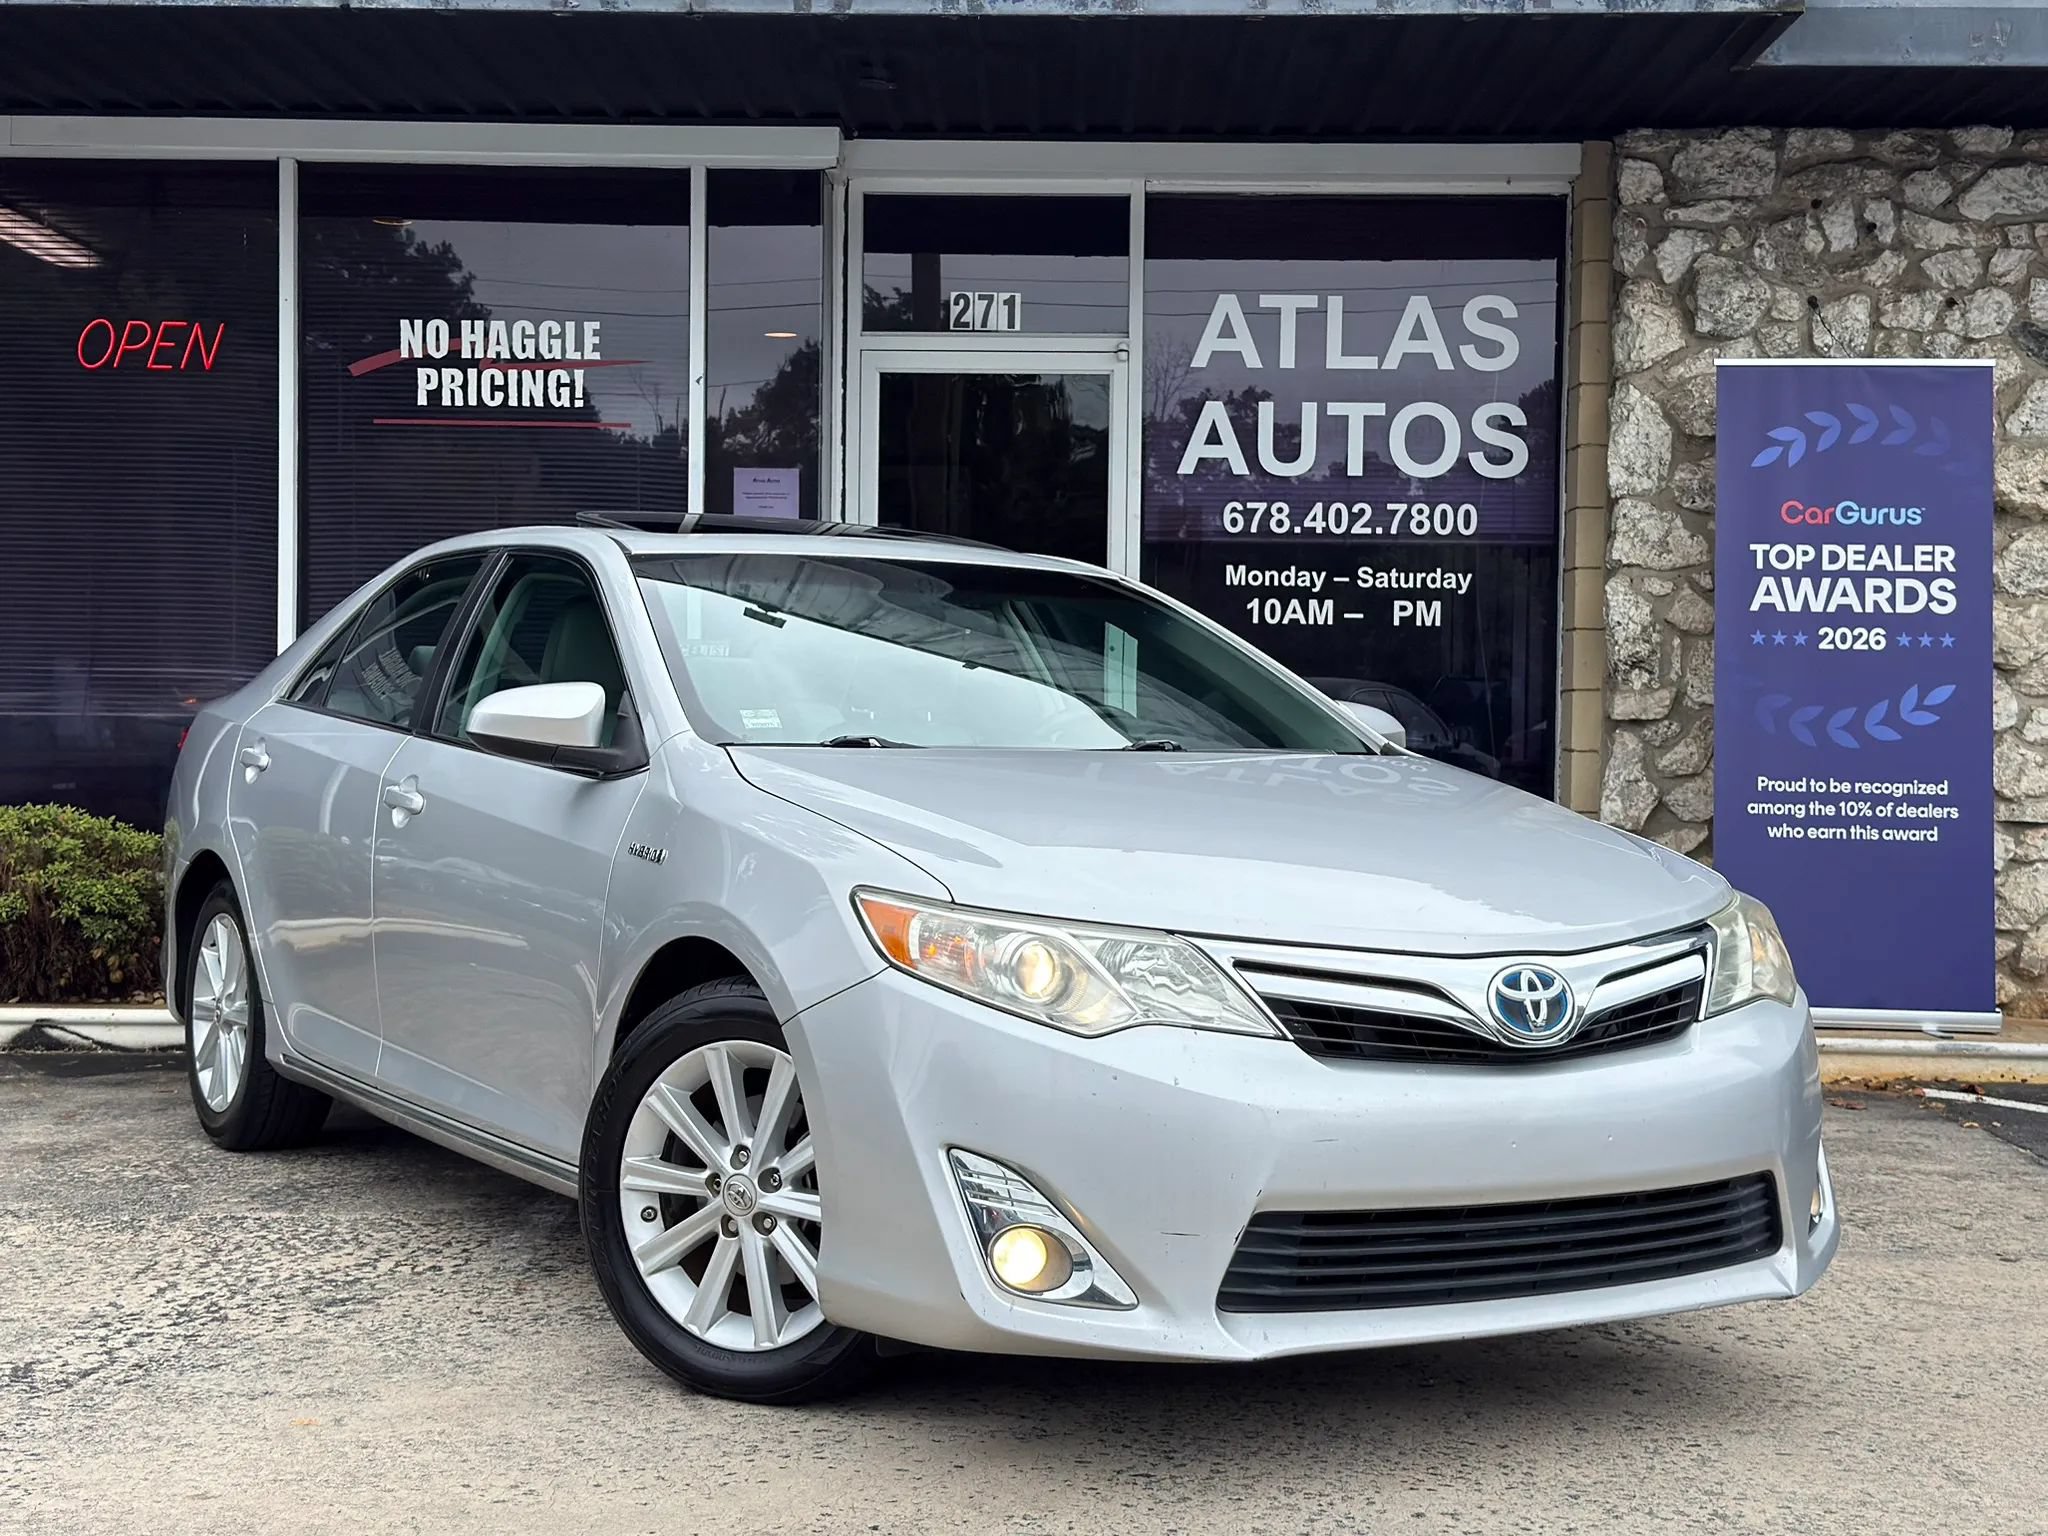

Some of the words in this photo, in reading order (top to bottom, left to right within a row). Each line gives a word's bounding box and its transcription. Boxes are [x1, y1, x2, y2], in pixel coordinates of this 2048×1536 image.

[952, 293, 1016, 329] 271
[77, 319, 224, 371] OPEN
[400, 319, 450, 359] NO
[460, 319, 602, 360] HAGGLE
[1190, 294, 1520, 371] ATLAS
[416, 367, 585, 408] PRICING!
[1177, 401, 1529, 479] AUTOS
[1222, 502, 1478, 536] 678.402.7800
[1781, 500, 1923, 525] CarGurus
[1749, 543, 1816, 571] TOP
[1821, 544, 1957, 573] DEALER
[1225, 564, 1327, 591] Monday
[1356, 567, 1473, 594] Saturday
[1246, 597, 1334, 625] 10AM
[1393, 600, 1442, 626] PM
[1749, 576, 1958, 615] AWARDS
[1818, 626, 1887, 651] 2026
[1757, 776, 1807, 792] Proud
[1810, 778, 1827, 793] to
[1829, 778, 1852, 793] be
[1854, 780, 1949, 798] recognized
[1747, 802, 1806, 818] among
[1808, 800, 1837, 816] the
[1839, 801, 1873, 817] 10%
[1875, 802, 1895, 818] of
[1895, 803, 1960, 819] dealers
[1767, 823, 1805, 838] who
[1807, 826, 1847, 840] earn
[1849, 824, 1880, 840] this
[1881, 826, 1939, 842] award
